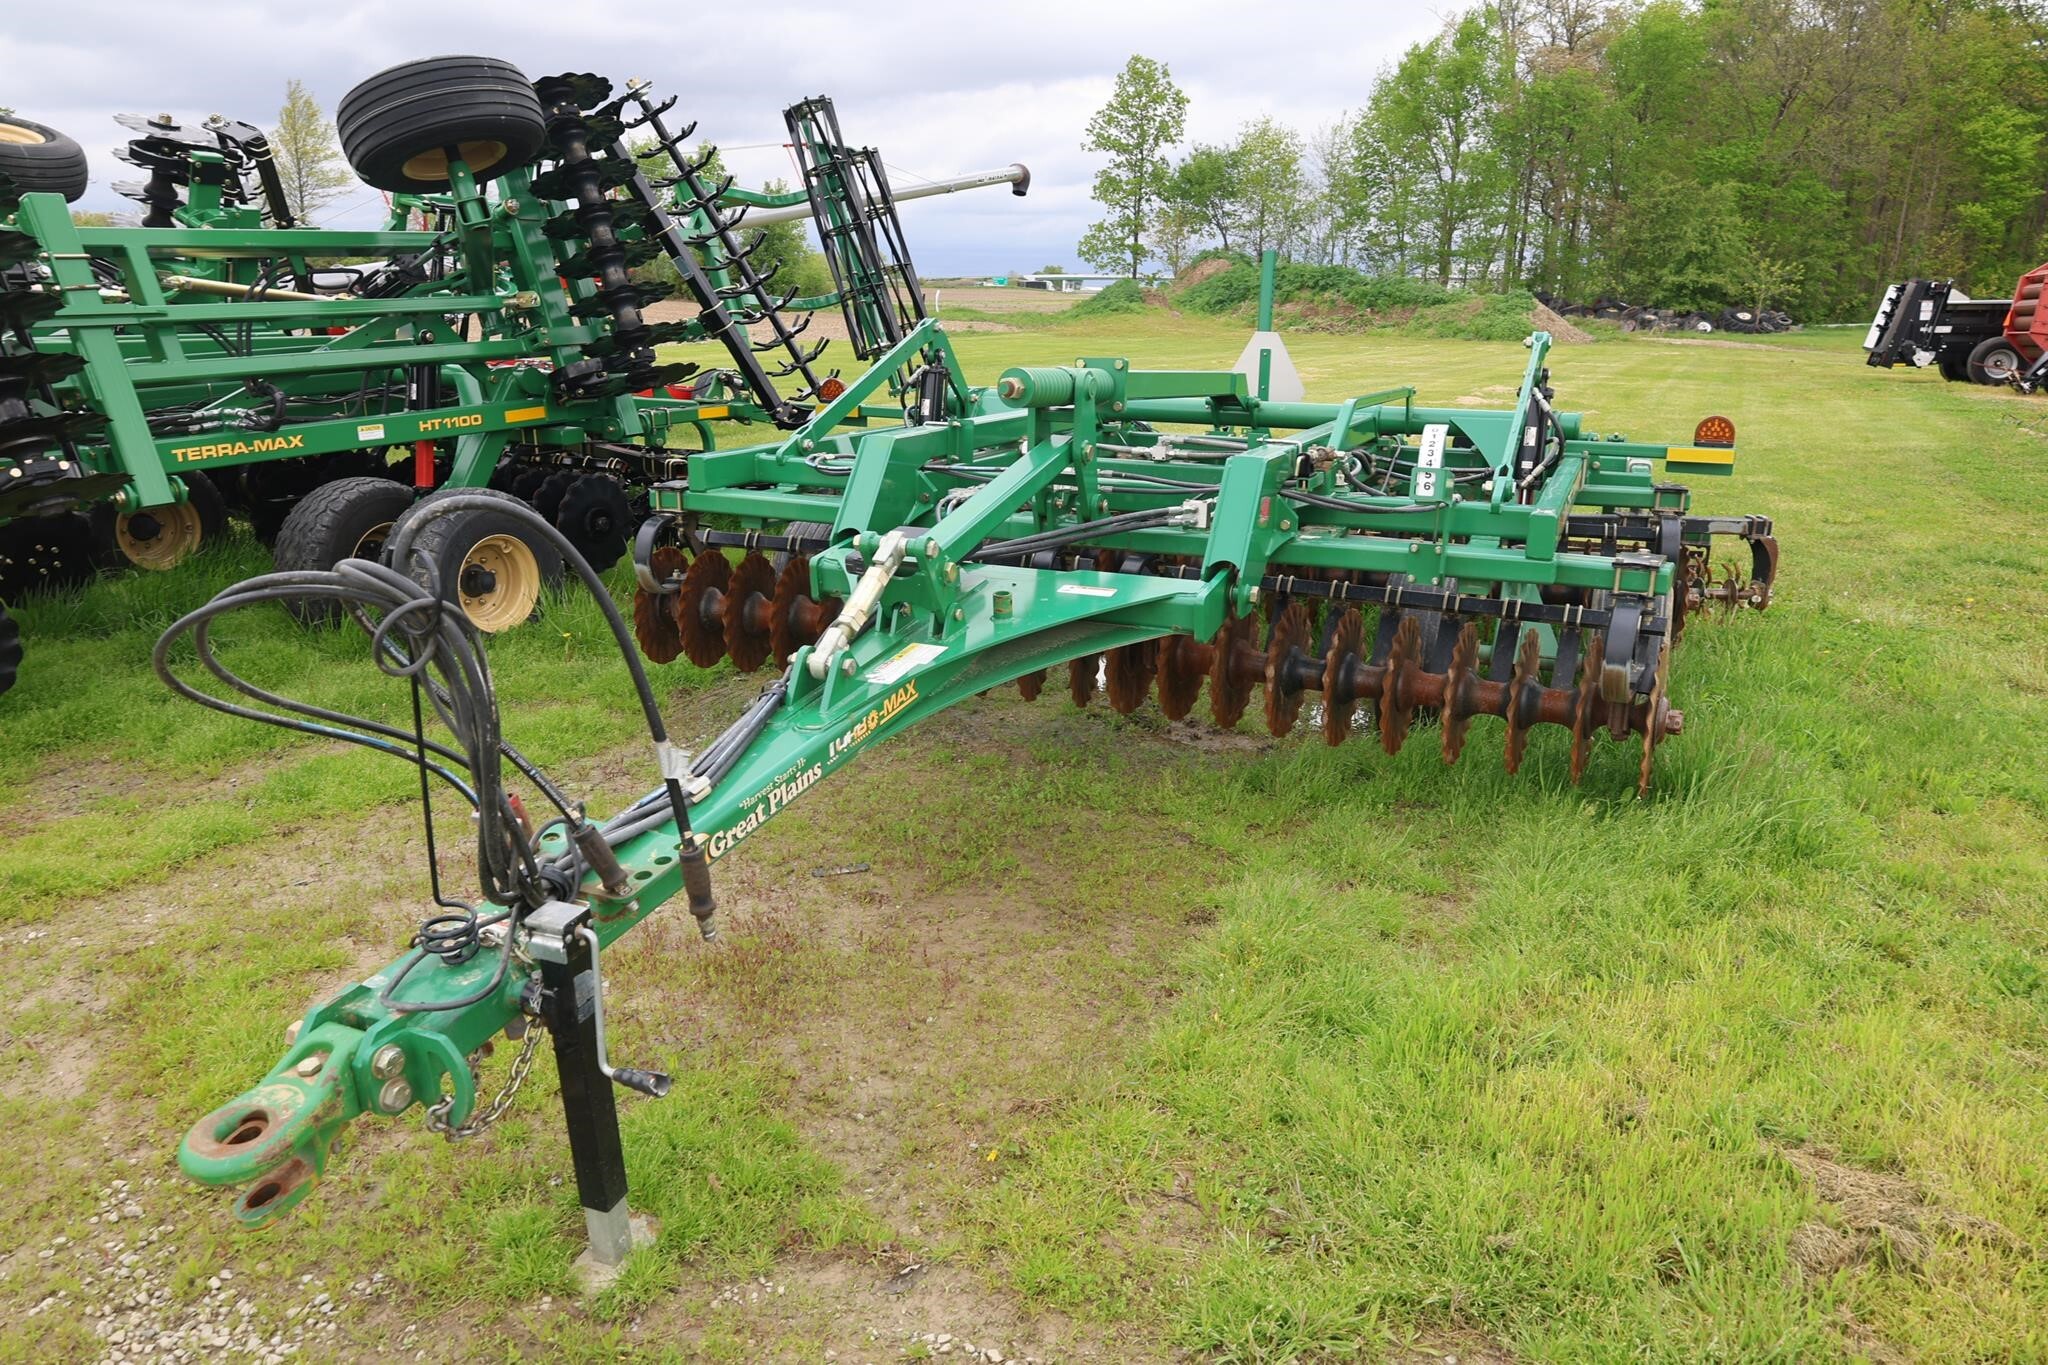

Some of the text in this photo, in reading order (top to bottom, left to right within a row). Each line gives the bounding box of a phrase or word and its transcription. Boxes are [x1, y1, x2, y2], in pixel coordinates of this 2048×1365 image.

[419, 414, 482, 432] HT1100
[171, 434, 304, 463] TERRA-MAX
[1423, 482, 1431, 490] 6
[708, 761, 823, 858] Great Plains
